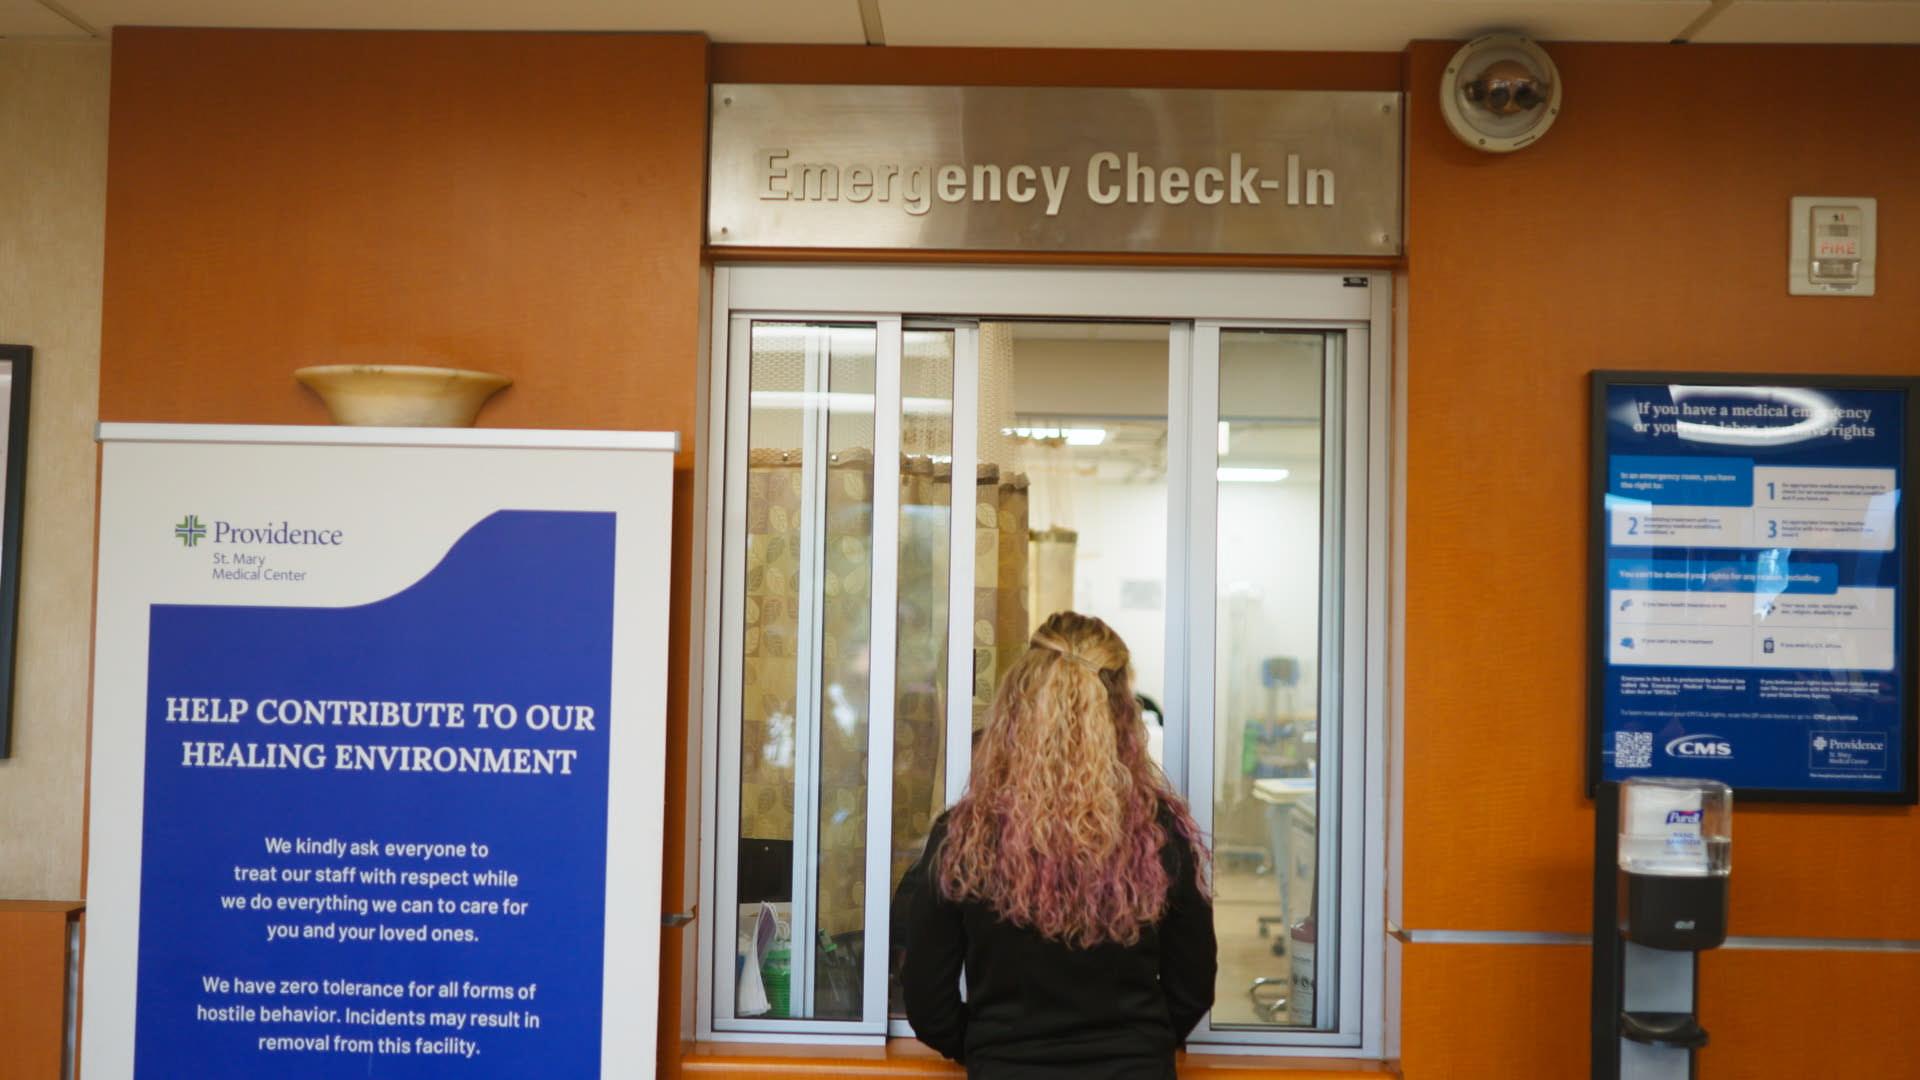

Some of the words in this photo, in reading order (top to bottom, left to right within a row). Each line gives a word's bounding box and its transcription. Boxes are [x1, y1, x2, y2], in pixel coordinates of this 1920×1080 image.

[759, 148, 1071, 215] Emergency
[1086, 151, 1336, 206] Check-In
[1820, 241, 1856, 255] FIRE
[1639, 402, 1650, 415] If
[1653, 405, 1679, 418] you
[1683, 403, 1717, 416] have
[1720, 407, 1729, 416] a
[1732, 404, 1788, 417] medical
[1791, 408, 1872, 422] emency
[1633, 423, 1649, 433] or
[1831, 424, 1875, 440] rights
[1767, 482, 1775, 500] 1
[213, 520, 344, 547] Providence
[1627, 516, 1638, 535] 2
[1767, 520, 1777, 538] 3
[213, 553, 230, 566] St.
[233, 553, 266, 568] Mary
[212, 568, 260, 580] Medical
[264, 570, 307, 581] Center
[165, 697, 249, 723] HELP
[256, 698, 465, 728] CONTRIBUTE
[472, 703, 518, 730] TO
[525, 704, 596, 731] OUR
[1678, 742, 1732, 756] CMS
[1829, 739, 1884, 750] Providence
[181, 741, 327, 769] HEALING
[334, 744, 578, 775] ENVIRONMENT
[264, 837, 292, 854] We
[296, 837, 347, 859] kindly
[349, 839, 379, 856] ask
[384, 843, 467, 861] everyone
[470, 842, 489, 858] to
[234, 866, 277, 882] treat
[281, 869, 312, 882] our
[315, 866, 357, 883] staff
[359, 867, 397, 885] with
[400, 870, 469, 889] respect
[472, 869, 519, 887] while
[221, 896, 247, 909] we
[250, 893, 273, 910] do
[276, 894, 369, 916] everything
[371, 899, 397, 913] we
[401, 900, 433, 914] can
[437, 898, 457, 914] to
[459, 900, 499, 915] care
[502, 898, 529, 916] for
[267, 925, 299, 942] you
[303, 922, 335, 939] and
[338, 926, 377, 943] your
[379, 924, 428, 942] loved
[431, 928, 479, 942] ones.
[202, 976, 230, 993] We
[234, 977, 276, 994] have
[279, 981, 319, 995] zero
[323, 979, 404, 998] tolerance
[407, 980, 435, 998] for
[438, 981, 459, 998] all
[462, 981, 515, 1000] forms
[517, 983, 537, 1000] of
[197, 1004, 256, 1022] hostile
[260, 1005, 341, 1023] behavior.
[345, 1007, 426, 1026] Incidents
[429, 1012, 467, 1030] may
[470, 1011, 521, 1028] result
[524, 1011, 540, 1029] in
[258, 1034, 330, 1051] removal
[333, 1035, 374, 1053] from
[377, 1037, 411, 1054] this
[415, 1037, 481, 1059] facility.
